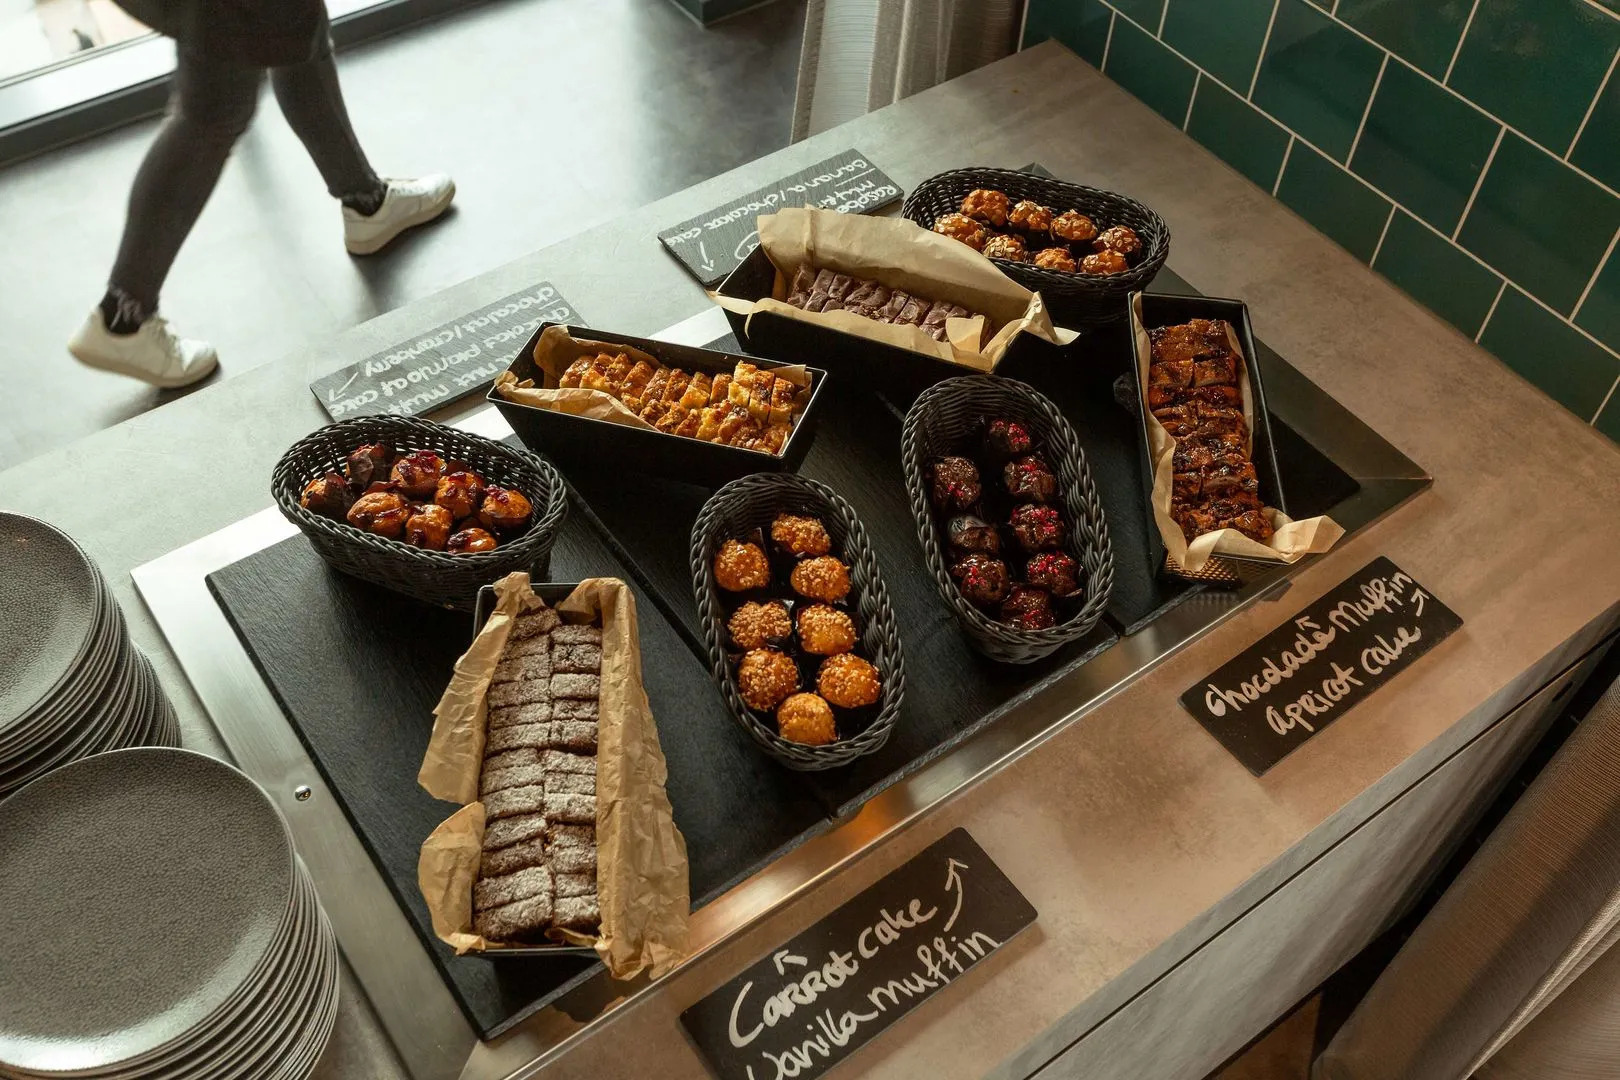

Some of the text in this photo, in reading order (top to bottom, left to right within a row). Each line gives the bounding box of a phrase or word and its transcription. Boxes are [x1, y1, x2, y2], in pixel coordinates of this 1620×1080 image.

[1360, 625, 1422, 676] cake
[858, 898, 938, 959] cake
[867, 930, 1004, 1011] muffin
